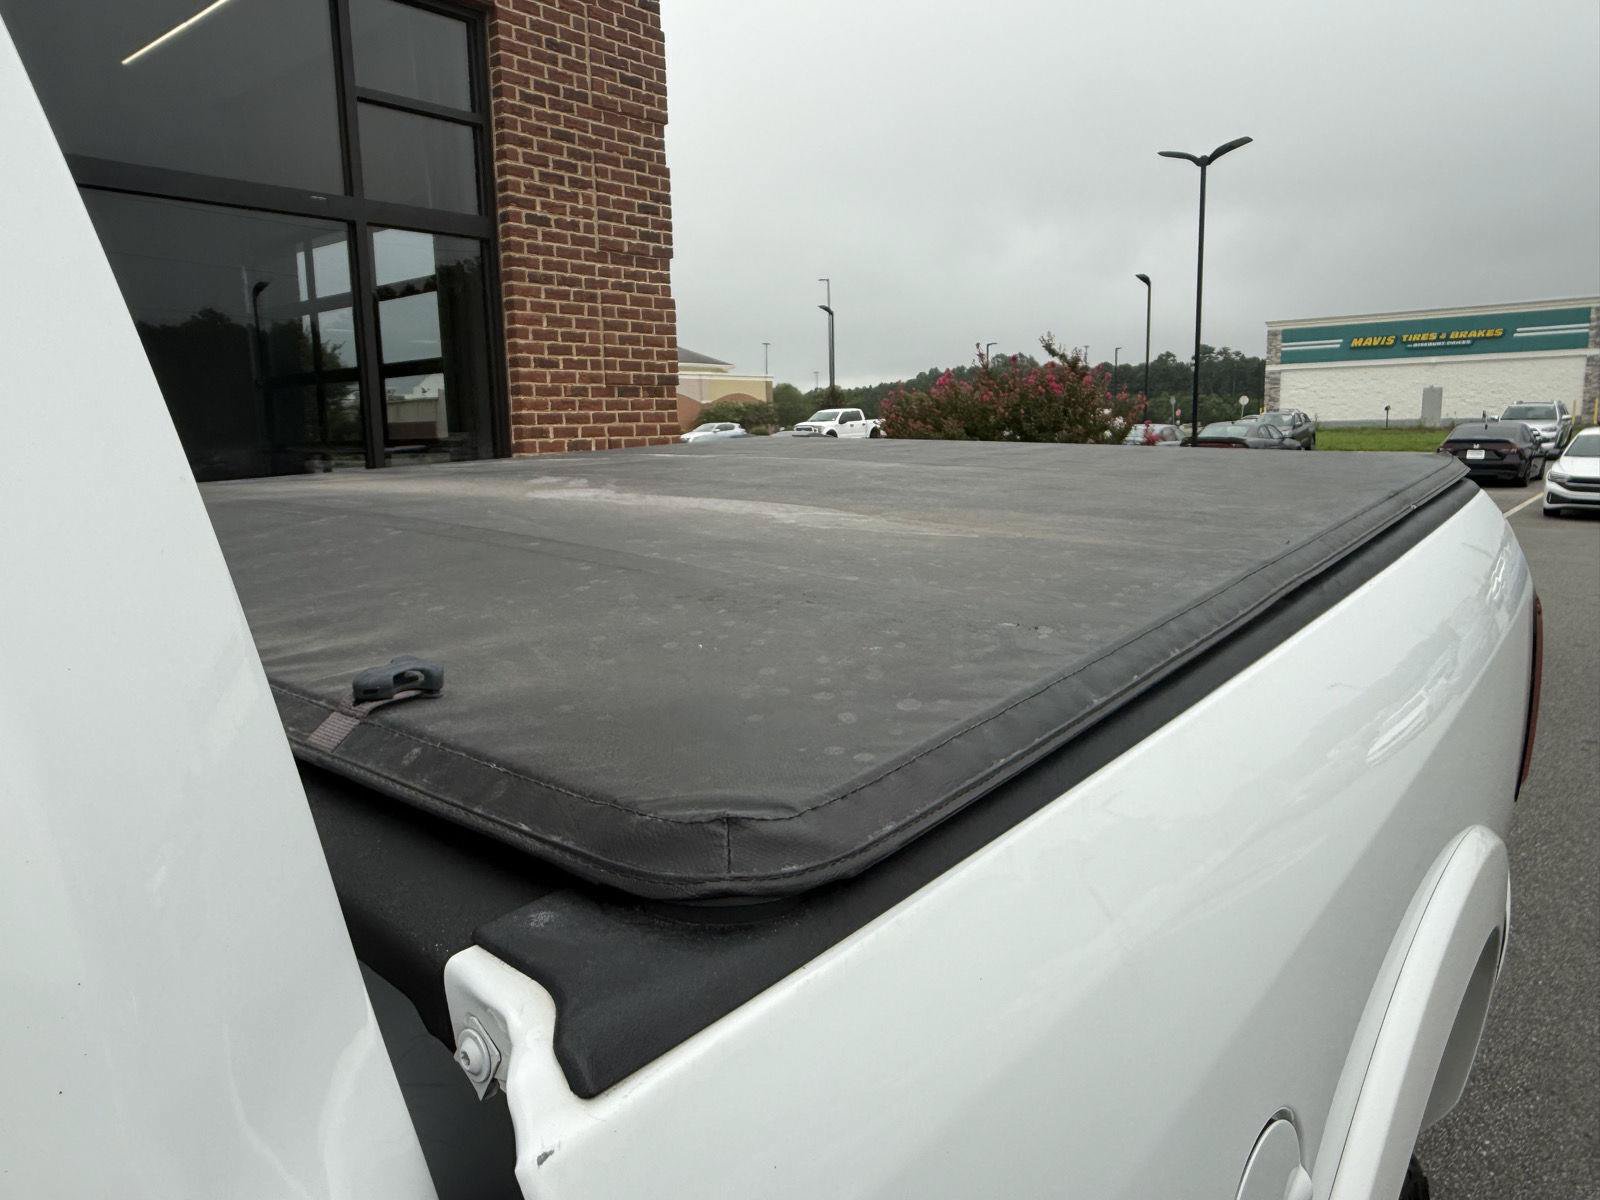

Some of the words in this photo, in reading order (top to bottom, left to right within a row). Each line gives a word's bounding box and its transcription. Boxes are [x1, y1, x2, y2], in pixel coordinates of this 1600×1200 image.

[1351, 336, 1396, 347] MAVIS
[1401, 332, 1437, 342] TIRES
[1450, 328, 1504, 339] BRAKES
